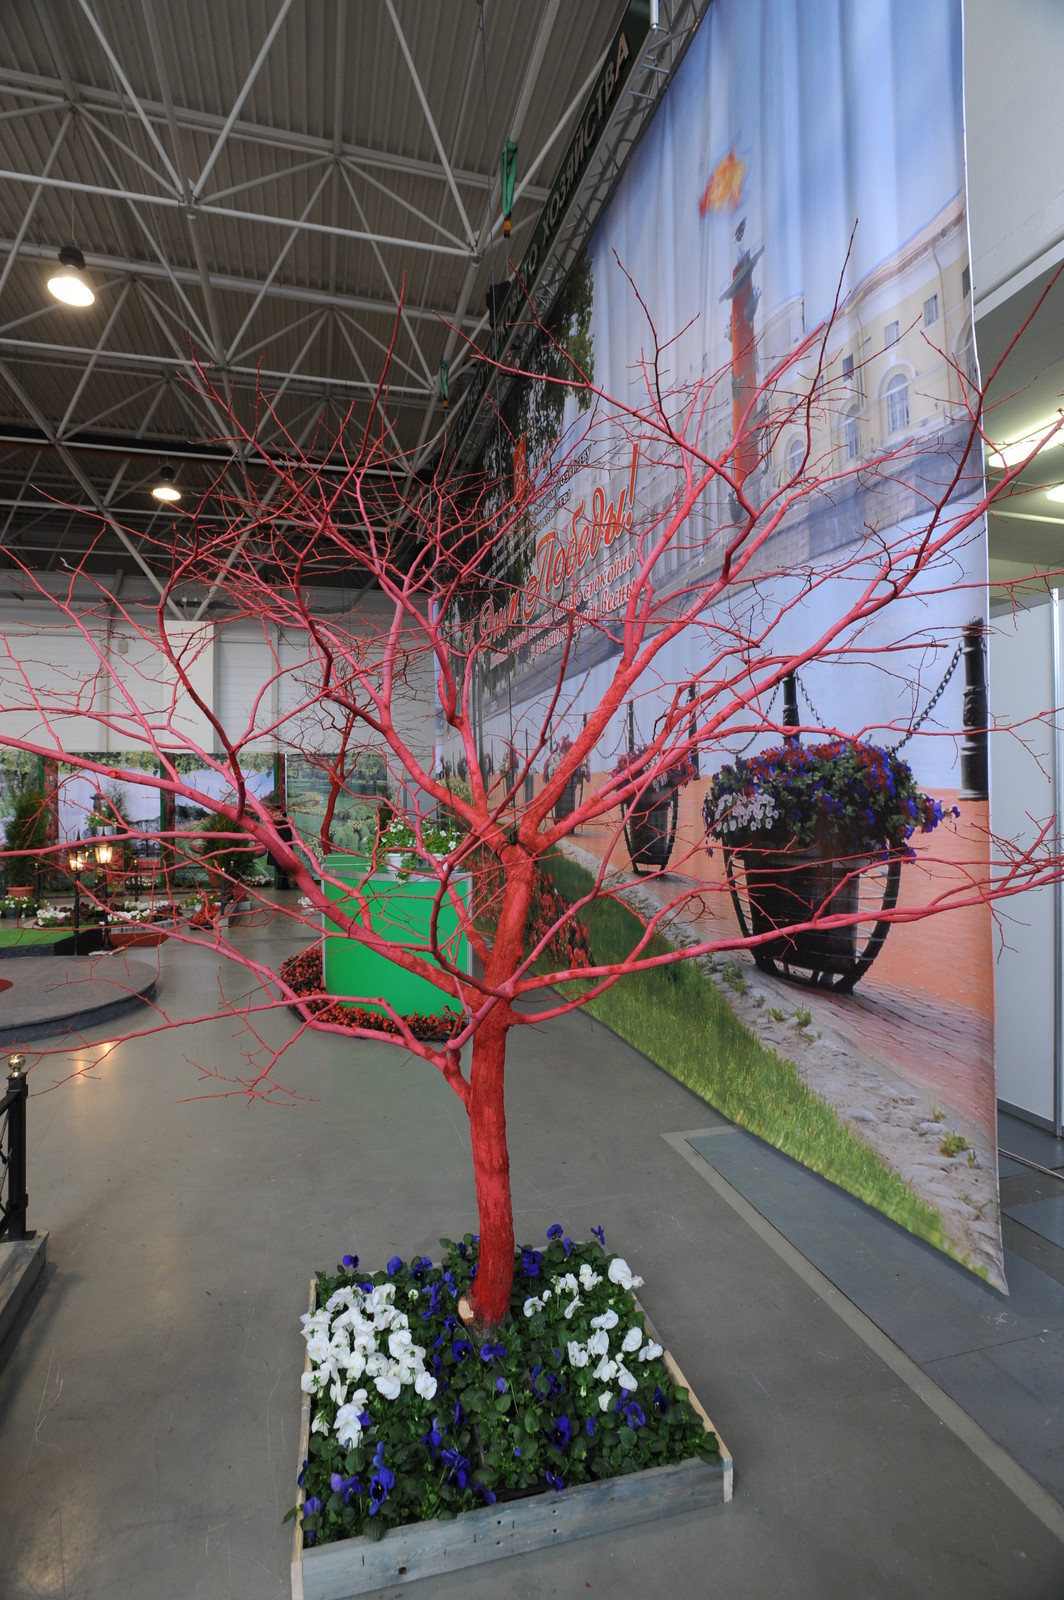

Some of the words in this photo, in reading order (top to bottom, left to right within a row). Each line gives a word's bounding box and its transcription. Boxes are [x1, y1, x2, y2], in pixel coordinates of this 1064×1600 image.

[542, 31, 630, 246] ХОЗЯЙСТВА
[523, 442, 639, 623] Победы!
[583, 548, 635, 602] спокойно
